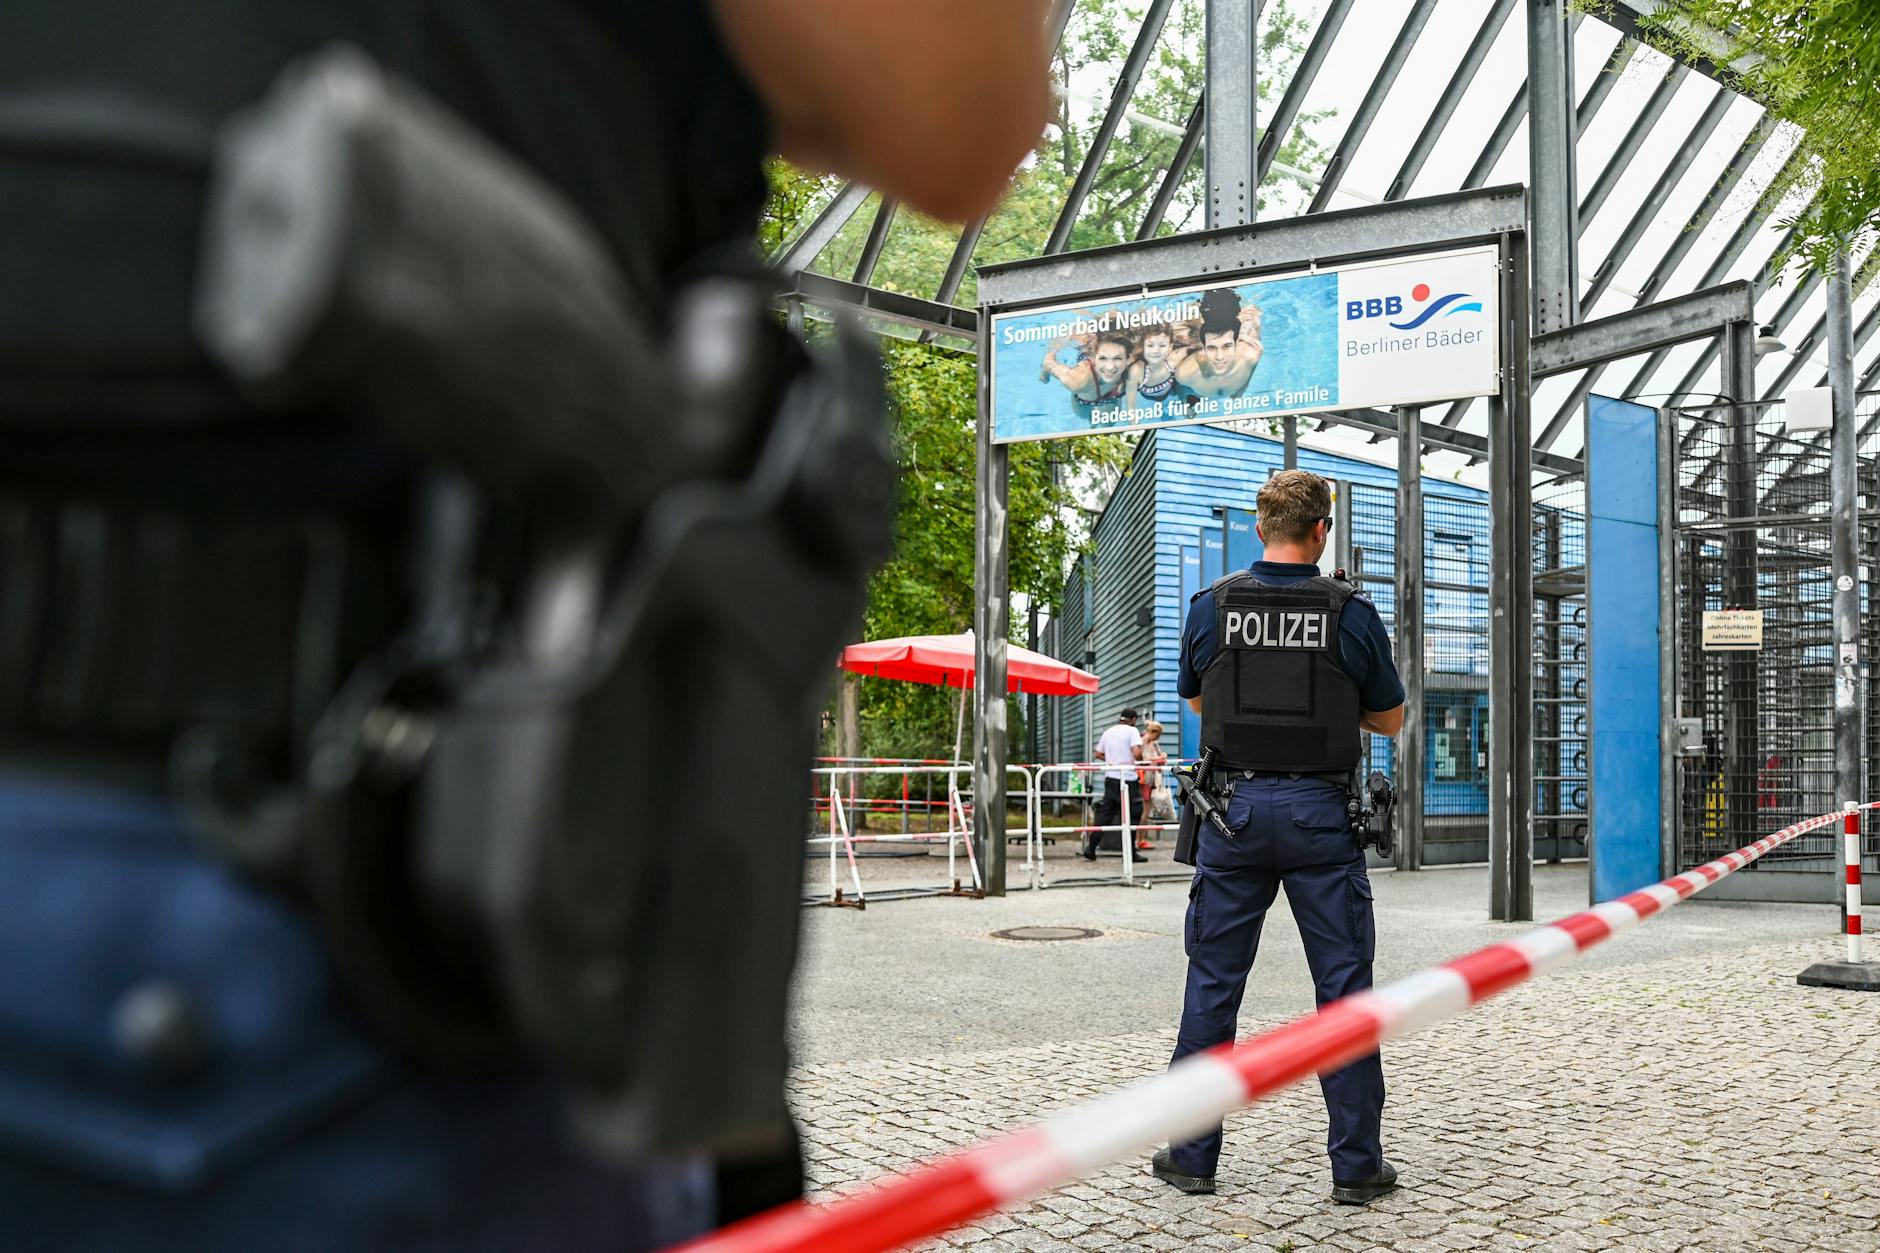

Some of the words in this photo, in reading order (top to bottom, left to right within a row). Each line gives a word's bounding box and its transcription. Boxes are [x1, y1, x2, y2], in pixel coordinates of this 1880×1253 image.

[1003, 313, 1110, 345] Sommerbad
[1116, 302, 1201, 330] Neukölln
[1347, 296, 1403, 320] BBB
[1347, 336, 1420, 357] Berliner
[1426, 328, 1483, 348] Bäder
[1091, 401, 1164, 426] Badespaß
[1167, 401, 1192, 416] für
[1194, 398, 1219, 412] die
[1223, 394, 1270, 415] ganze
[1275, 385, 1329, 406] Famile
[1230, 521, 1249, 532] Kasse
[1225, 611, 1327, 648] POLIZEI
